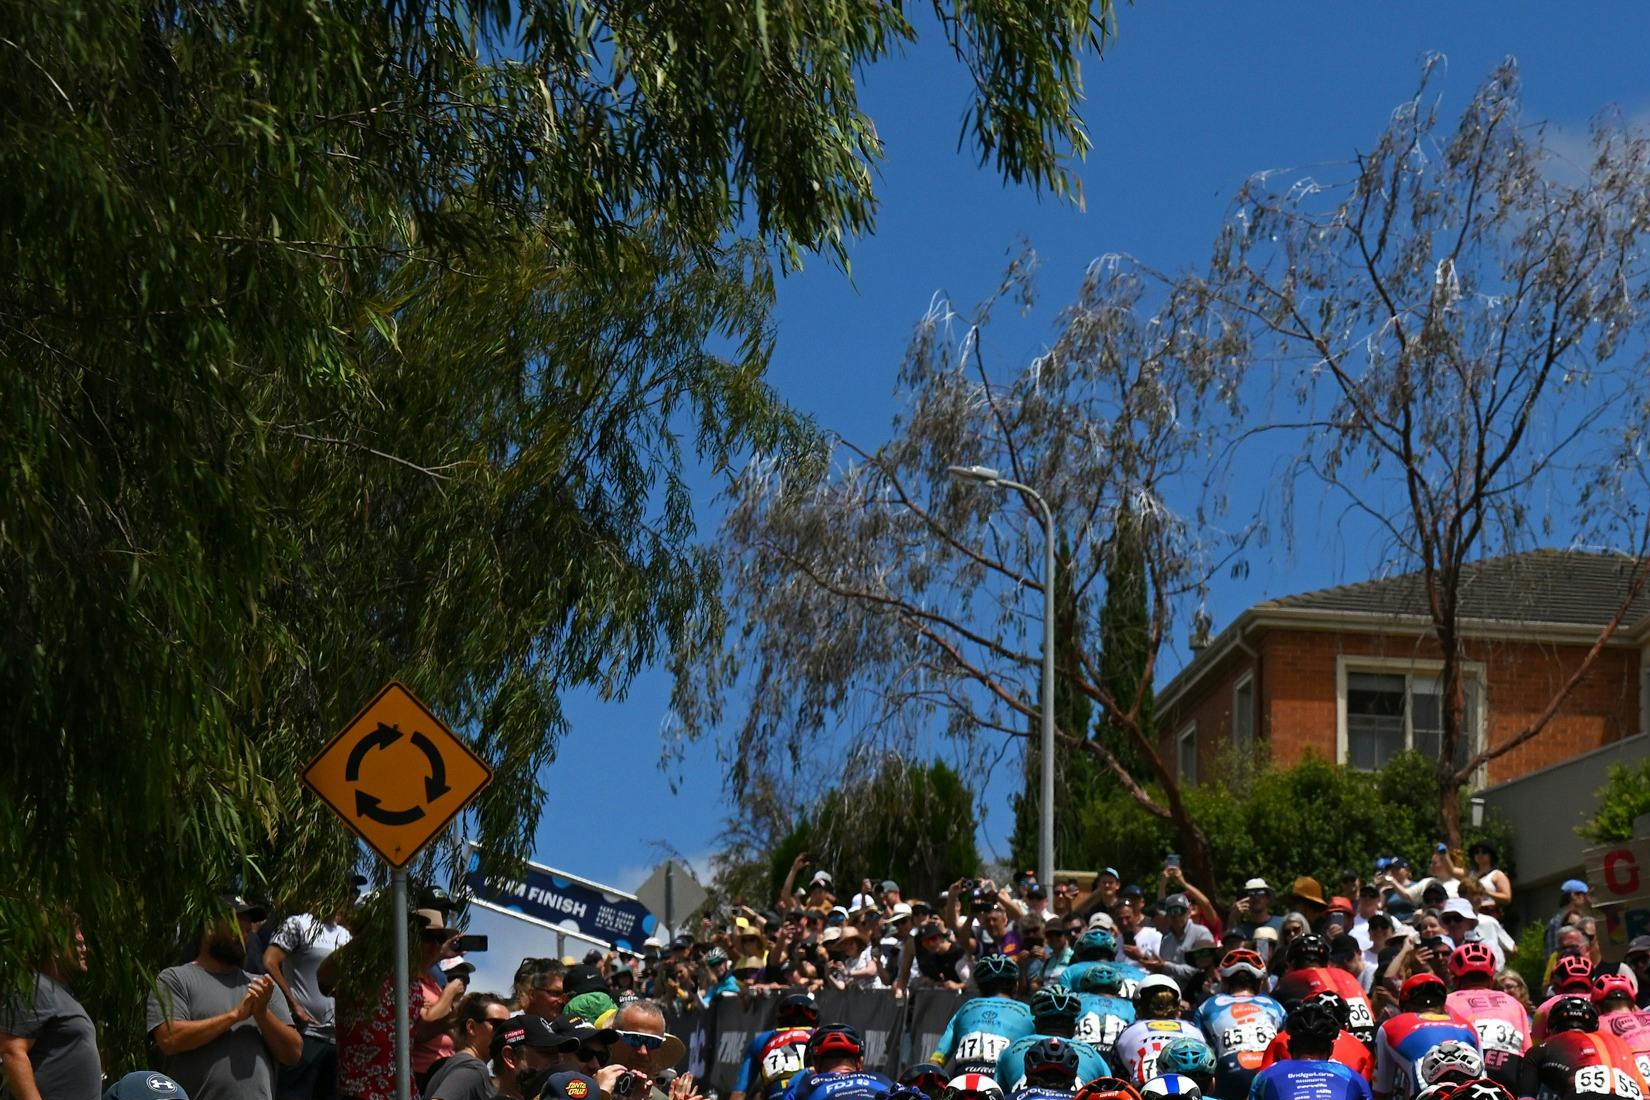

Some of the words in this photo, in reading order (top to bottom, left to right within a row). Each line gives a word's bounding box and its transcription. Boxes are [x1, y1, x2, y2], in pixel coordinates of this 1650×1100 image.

[528, 887, 587, 918] FINISH
[960, 1038, 977, 1058] 17
[1485, 1052, 1509, 1066] EF
[810, 1073, 877, 1085] Groupama
[1581, 1071, 1605, 1088] 55
[1619, 1074, 1640, 1097] 55
[567, 1087, 587, 1099] CRUZ
[826, 1080, 854, 1094] FDJ
